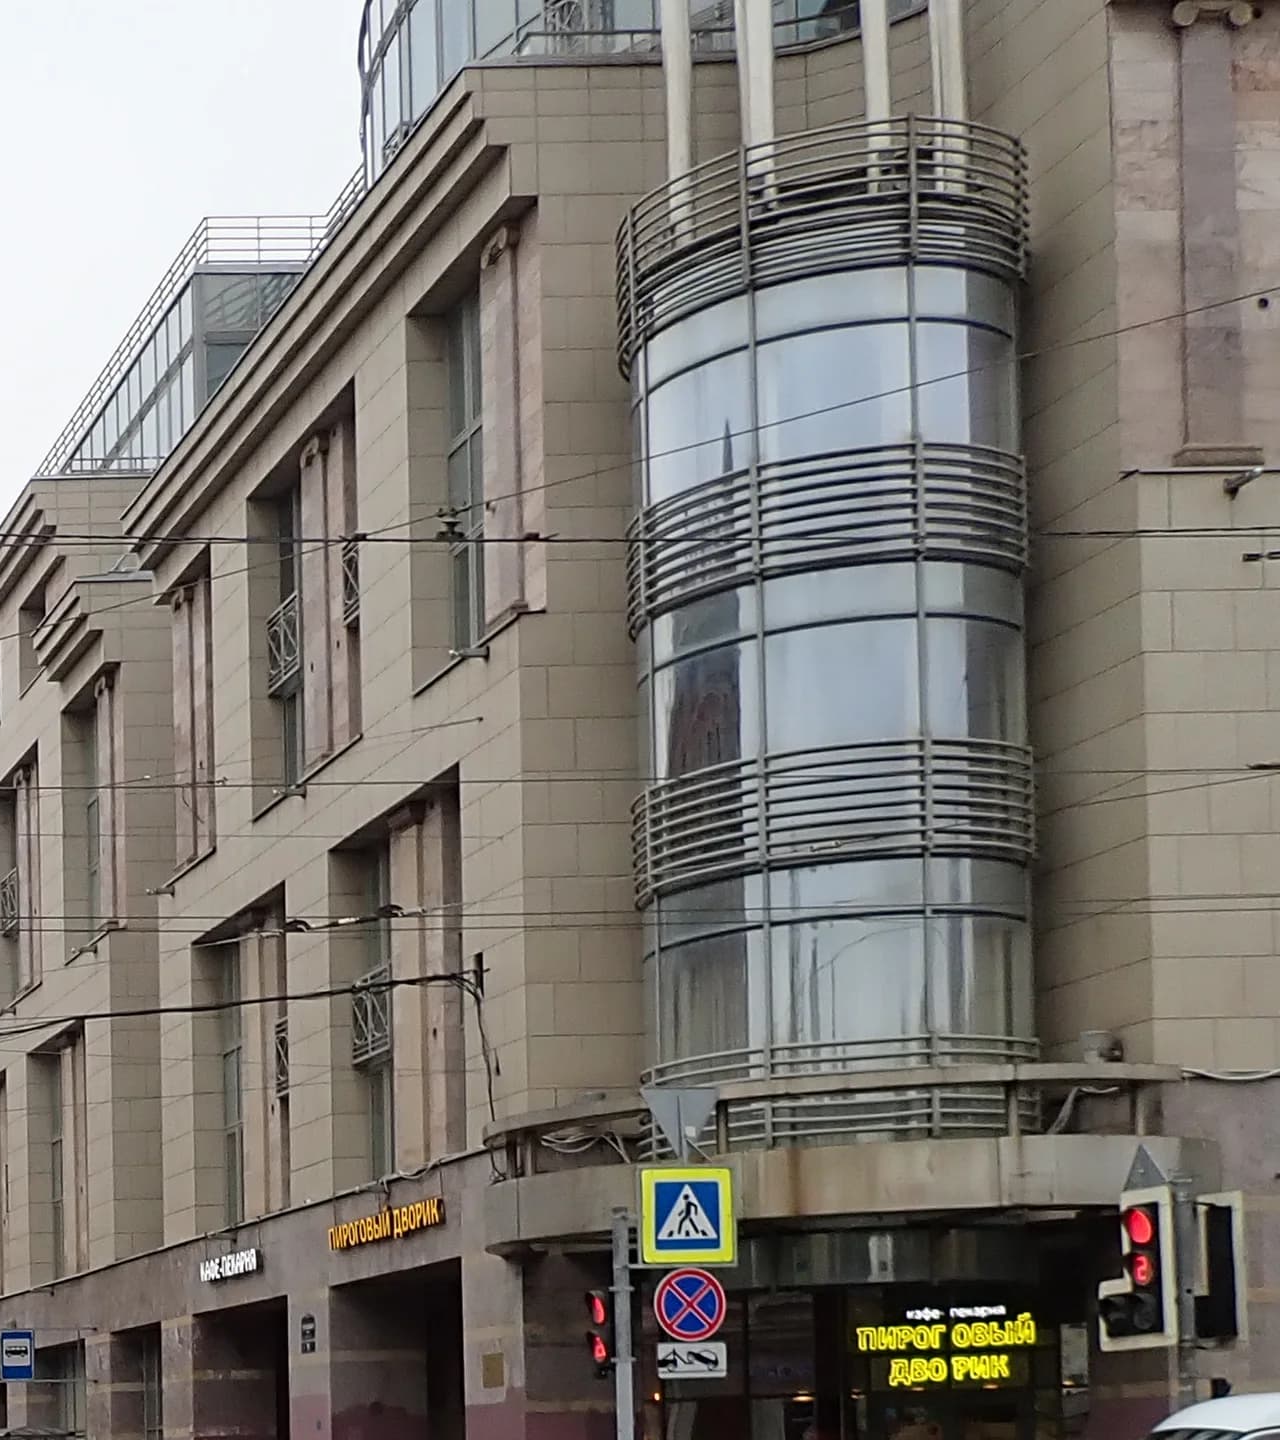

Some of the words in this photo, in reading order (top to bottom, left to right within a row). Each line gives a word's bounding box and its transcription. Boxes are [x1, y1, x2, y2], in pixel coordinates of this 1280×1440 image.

[328, 1204, 391, 1251] ПИРОГОВЫЙ
[393, 1197, 439, 1239] ДВОРИК
[199, 1248, 257, 1282] КАФЕ-ПЕКАРНЯ
